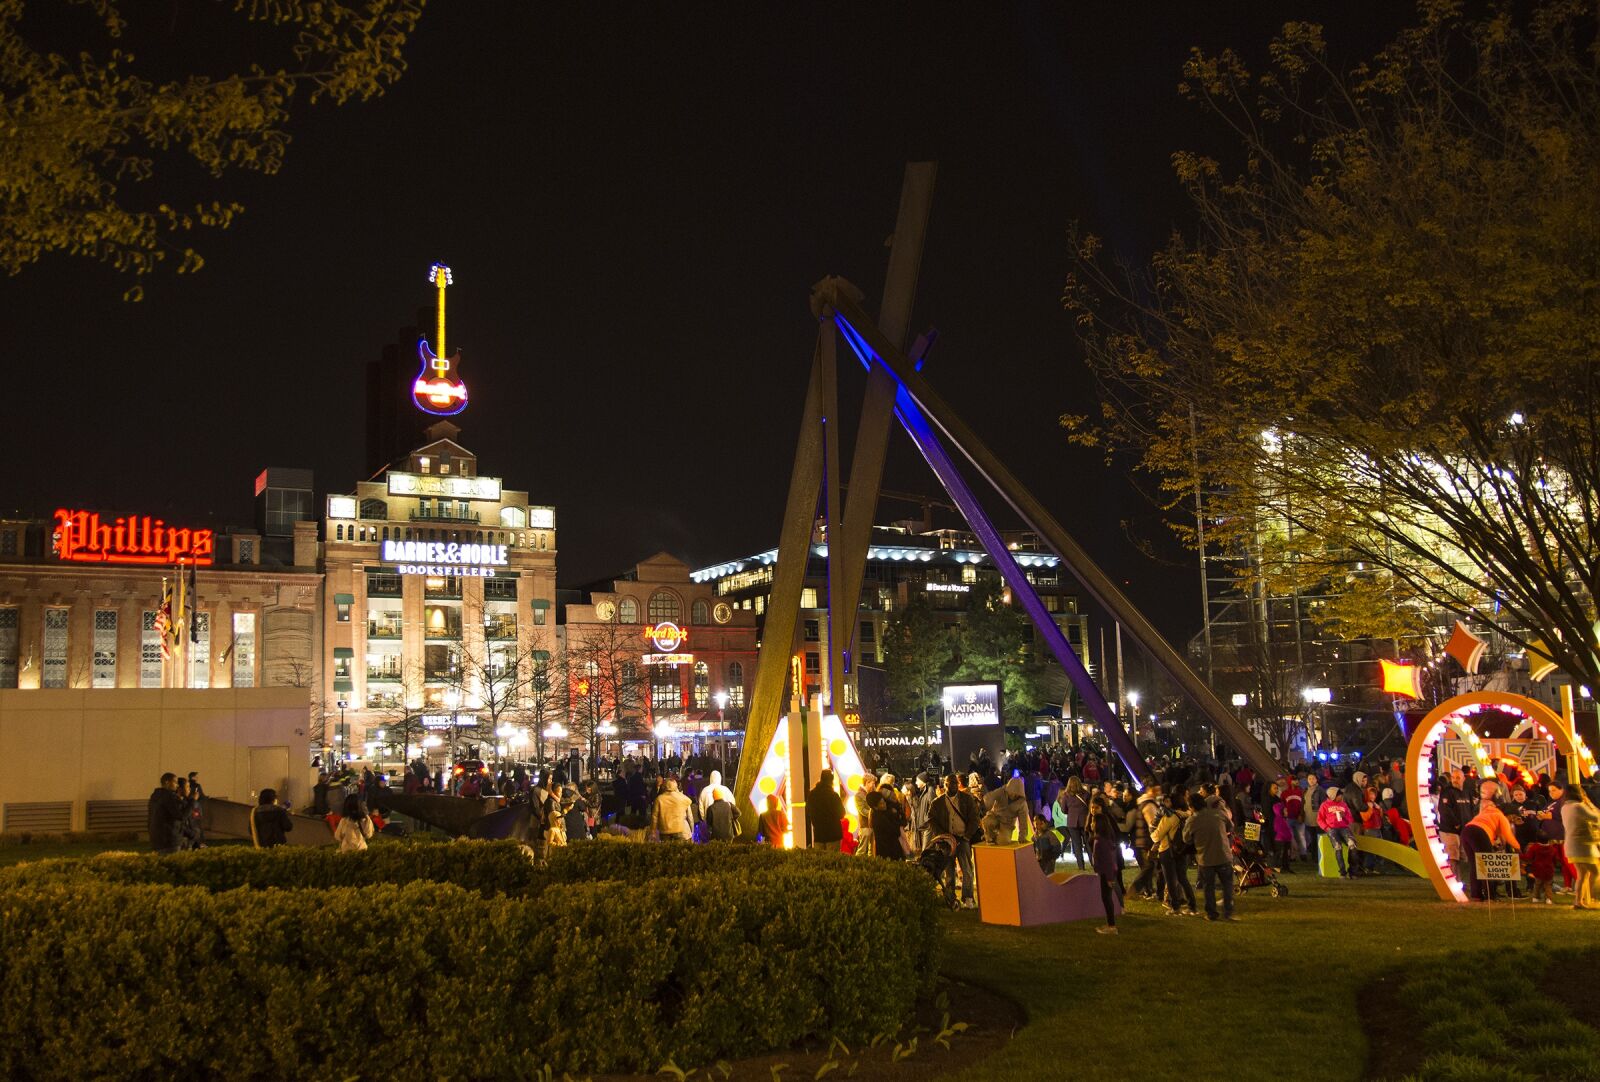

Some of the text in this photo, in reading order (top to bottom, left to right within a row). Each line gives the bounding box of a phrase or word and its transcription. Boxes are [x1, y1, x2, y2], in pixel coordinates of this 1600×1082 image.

[53, 508, 213, 563] Phillips
[398, 565, 496, 577] BOOKSELLERS
[644, 626, 688, 641] Hard Rock
[949, 703, 995, 713] NATIONAL
